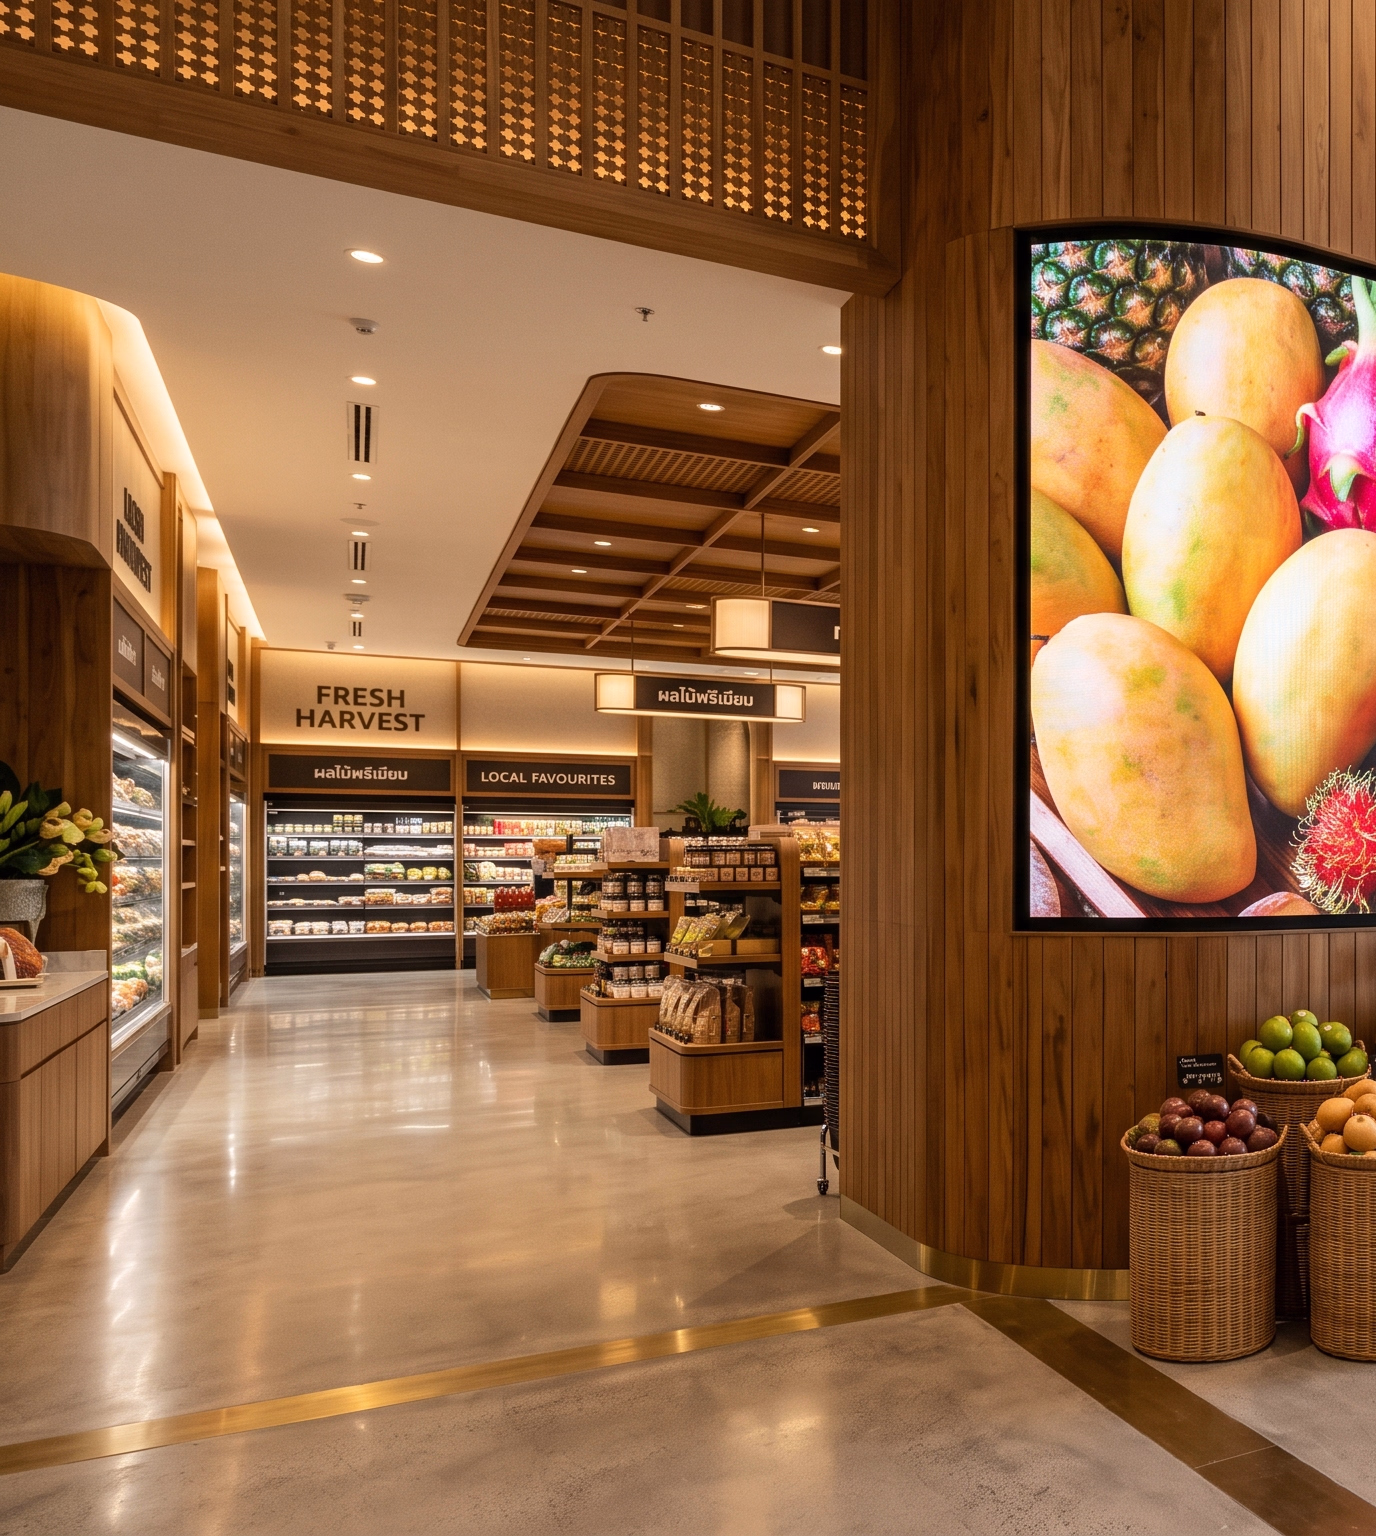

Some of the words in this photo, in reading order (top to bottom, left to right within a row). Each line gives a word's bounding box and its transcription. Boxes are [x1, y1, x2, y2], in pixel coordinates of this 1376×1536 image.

[317, 685, 405, 708] FRESH
[295, 708, 426, 732] HARVEST
[481, 771, 527, 783] LOCAL
[532, 773, 616, 785] FAVOURITES
